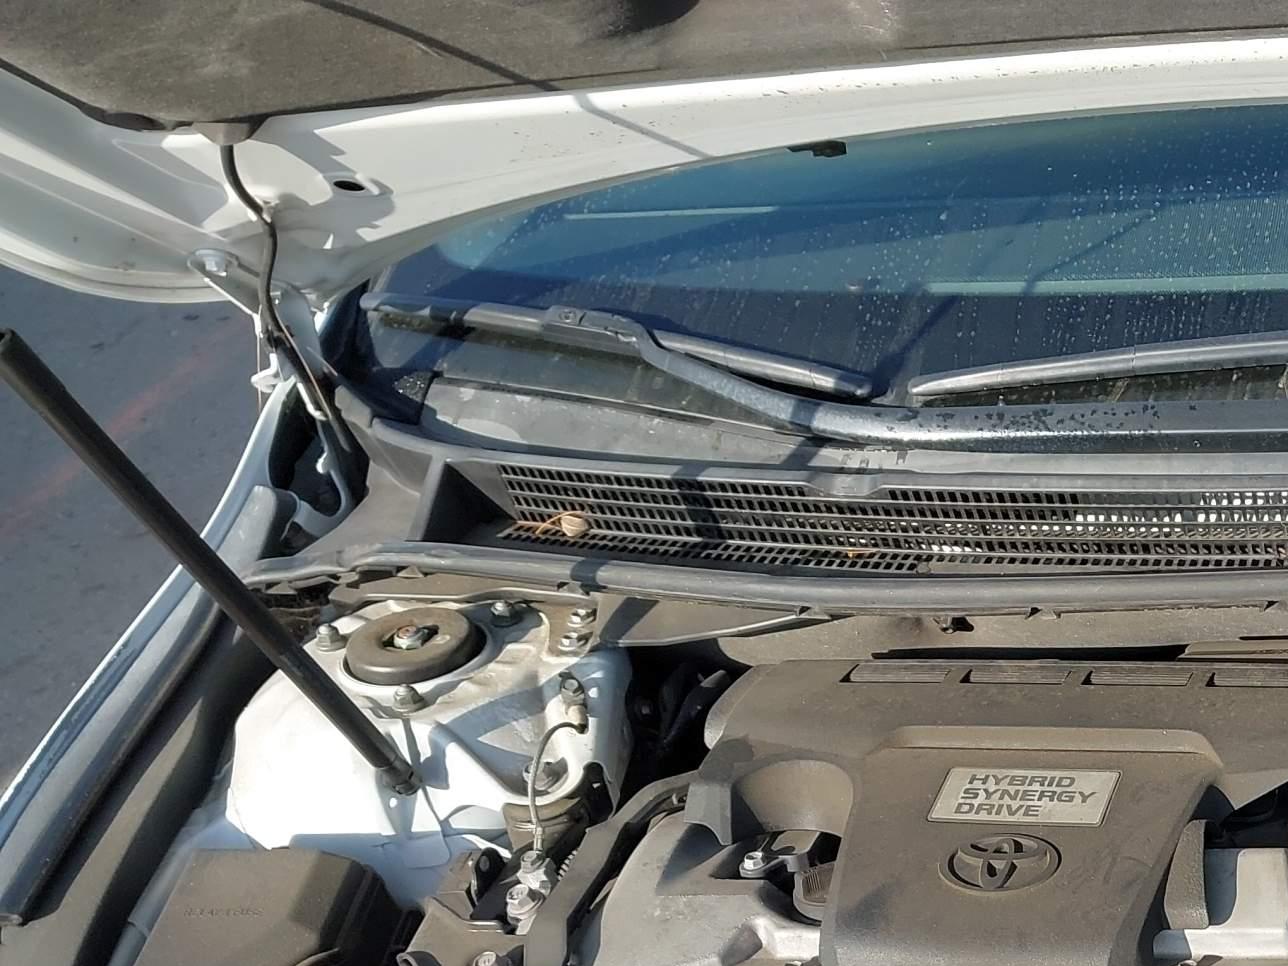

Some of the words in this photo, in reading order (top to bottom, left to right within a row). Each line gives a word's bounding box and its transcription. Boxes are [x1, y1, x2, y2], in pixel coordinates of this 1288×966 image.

[967, 774, 1075, 788] HYBRID
[960, 787, 1098, 804] SYNERGY
[954, 802, 1043, 817] DRIVE
